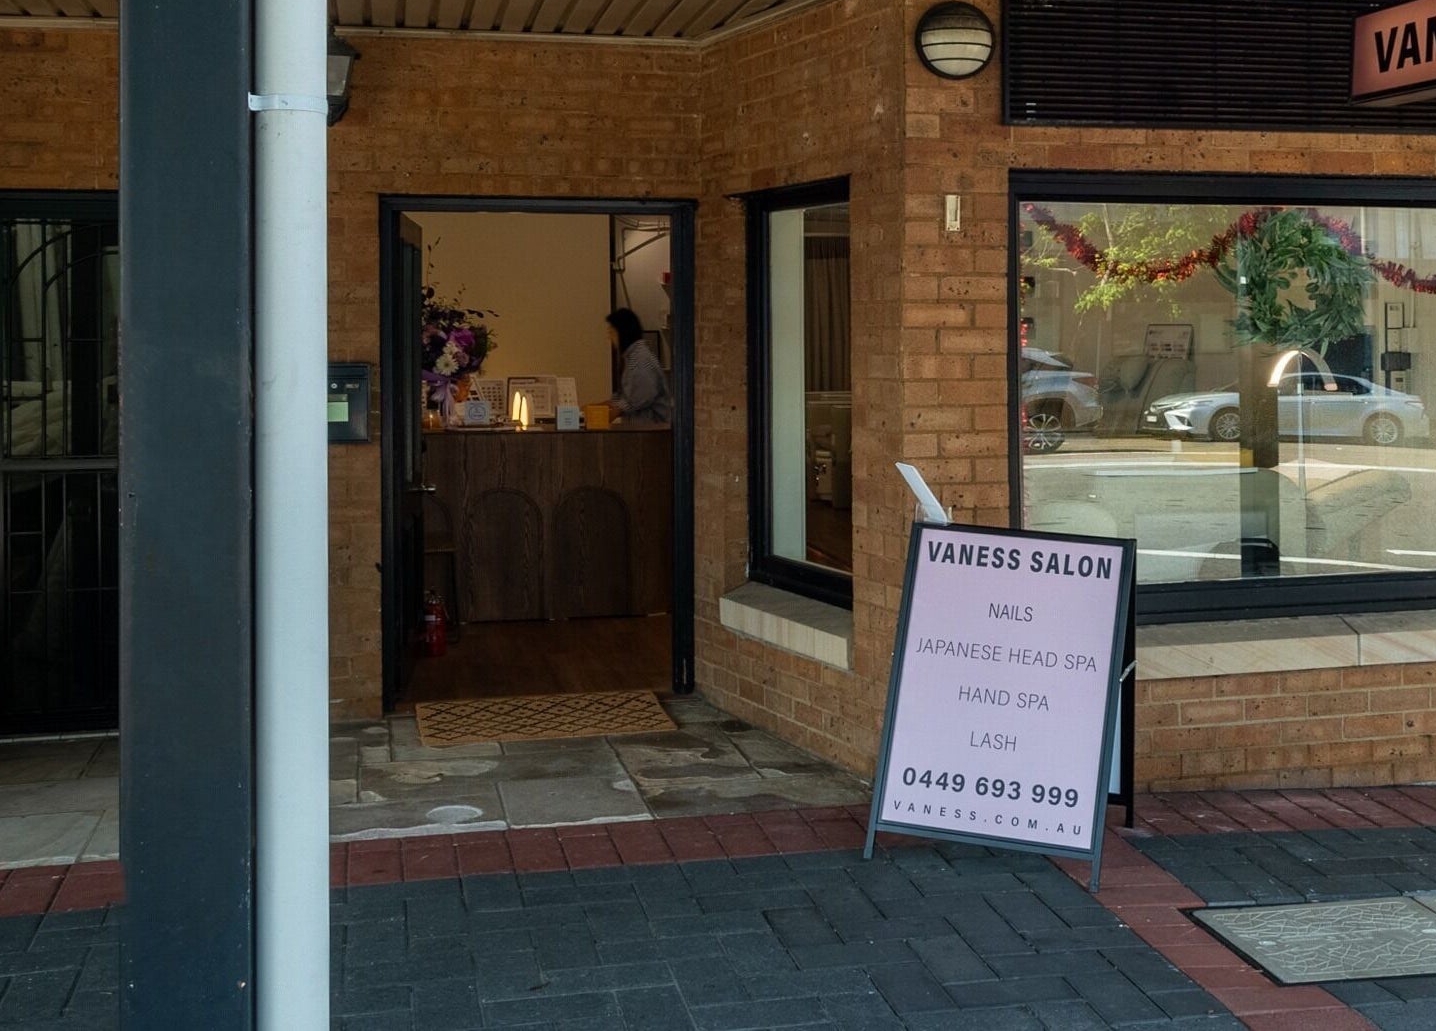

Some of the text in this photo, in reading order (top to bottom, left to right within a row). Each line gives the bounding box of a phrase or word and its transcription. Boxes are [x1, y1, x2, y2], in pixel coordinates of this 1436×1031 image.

[928, 541, 1112, 579] VANESS SALON
[988, 603, 1034, 622] NAILS
[915, 638, 1097, 672] JAPANESE HEAD SPA
[958, 686, 1049, 711] HAND SPA
[970, 731, 1017, 752] LASH
[902, 767, 1079, 808] 0449 693 999
